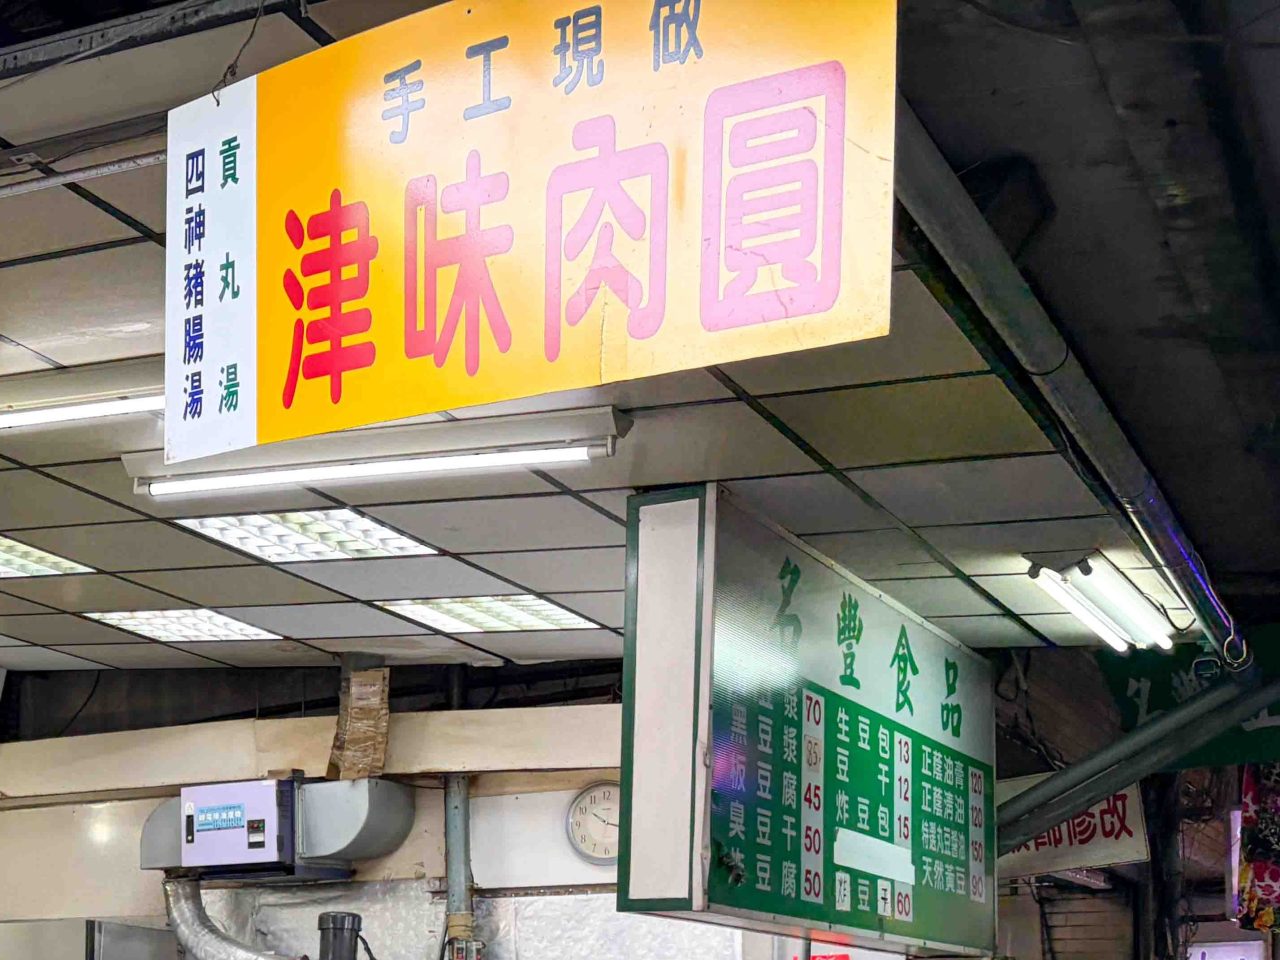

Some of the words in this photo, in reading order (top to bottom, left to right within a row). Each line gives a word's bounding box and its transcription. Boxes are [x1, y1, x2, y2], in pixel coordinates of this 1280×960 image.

[381, 0, 704, 144] 手工現做
[282, 60, 846, 409] 津味肉圓
[182, 147, 206, 421] 四神豬腸湯
[218, 136, 240, 415] 貢丸湯
[805, 694, 822, 726] 70
[836, 706, 890, 759] 生豆包
[897, 738, 910, 764] 13
[804, 782, 821, 811] 45
[836, 747, 890, 796] 豆干
[897, 777, 910, 802] 12
[804, 825, 821, 855] 50
[836, 790, 890, 837] 炸豆包
[897, 816, 910, 840] 15
[804, 868, 821, 898] 50
[897, 891, 911, 917] 60
